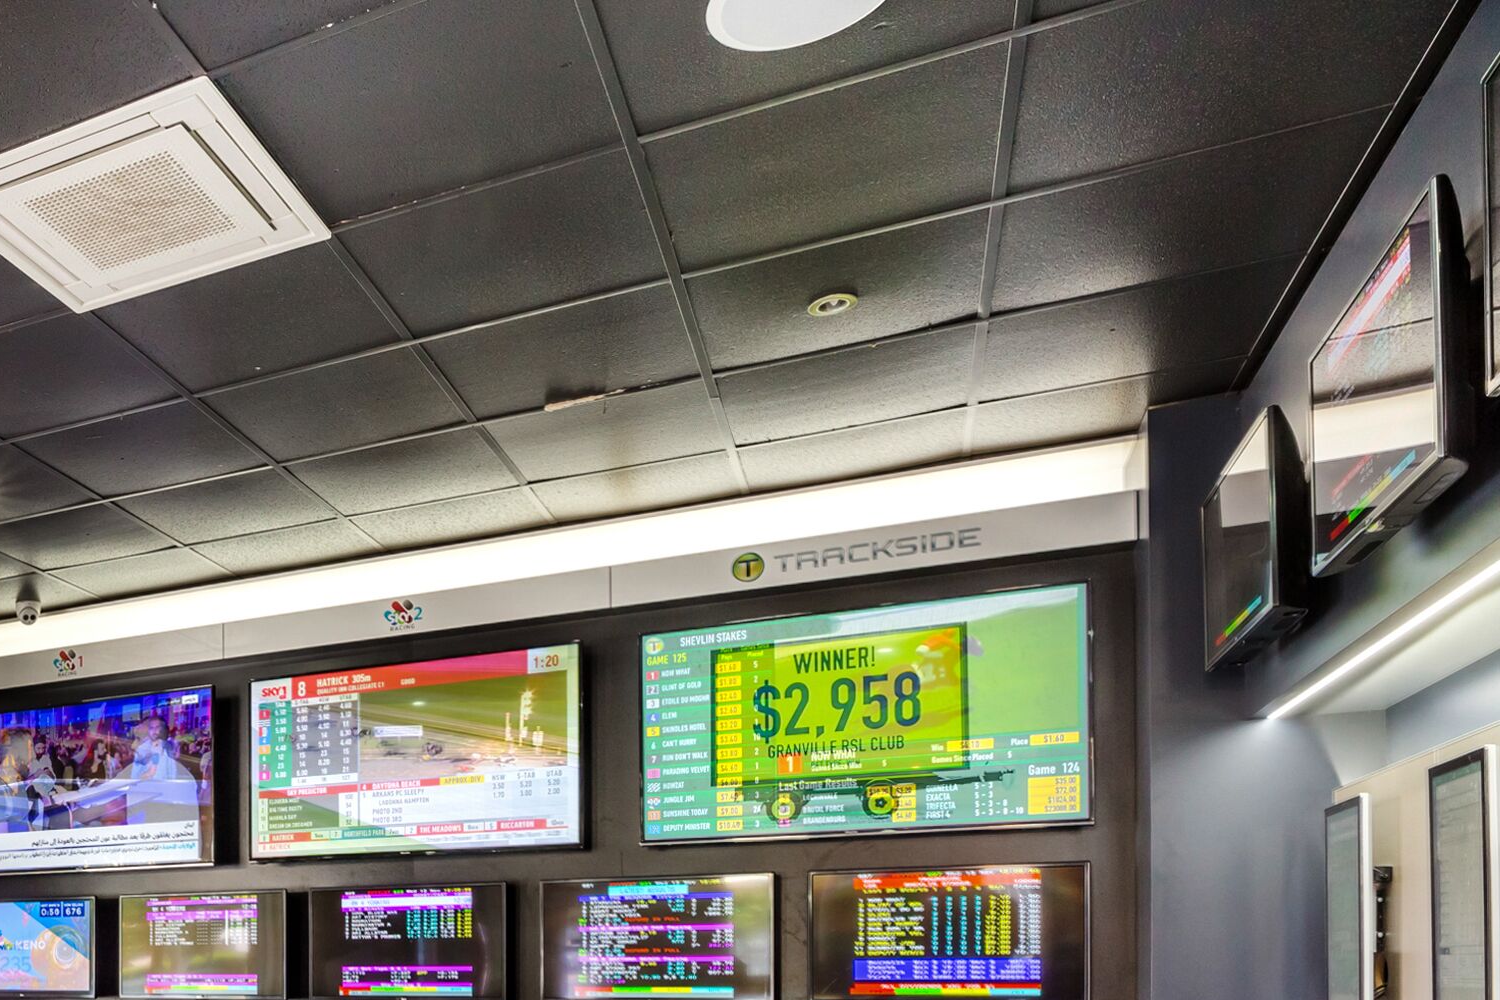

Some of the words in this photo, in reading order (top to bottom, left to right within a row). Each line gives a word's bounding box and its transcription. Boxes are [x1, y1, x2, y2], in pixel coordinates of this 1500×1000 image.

[738, 559, 758, 578] T
[774, 527, 982, 573] TRACKSIDE
[414, 606, 423, 621] 2
[680, 633, 715, 647] SHEVLIN
[716, 630, 747, 643] STAKES
[78, 655, 83, 667] 1
[533, 655, 559, 669] 1:20
[647, 654, 668, 666] GAME
[673, 653, 687, 663] 125
[793, 646, 876, 674] WINNER!
[661, 669, 674, 677] NOW
[675, 668, 690, 676] WHAT
[298, 681, 306, 697] 8
[316, 675, 348, 687] HATRICK
[351, 674, 371, 684] 305m
[753, 671, 921, 743] $2,958
[689, 723, 706, 731] HOTEL
[662, 739, 678, 748] CAN'T
[768, 739, 837, 758] GRANVILLE
[842, 736, 866, 753] RSL
[870, 735, 904, 750] CLUB
[811, 751, 830, 761] NOW
[833, 749, 856, 760] WHAT
[1010, 738, 1028, 746] Place
[1043, 735, 1065, 743] $1.60
[662, 753, 674, 762] RUN
[675, 752, 690, 760] DON'T
[691, 752, 708, 760] WALK
[932, 756, 952, 764] Games
[953, 754, 971, 762] Since
[972, 753, 994, 761] Placed
[691, 765, 710, 774] VELVET
[1028, 764, 1056, 776] Game
[1062, 762, 1080, 773] 124
[372, 781, 399, 790] DAYTONA
[401, 779, 420, 788] BEACH
[779, 781, 797, 791] Last
[799, 780, 823, 790] Game
[825, 777, 857, 788] Results
[926, 793, 951, 801] EXACTA
[926, 802, 956, 810] TRIFECTA
[663, 809, 689, 817] SUNSHINE
[691, 808, 708, 816] TODAY
[926, 811, 946, 819] FIRST
[420, 825, 430, 833] THE
[431, 824, 462, 833] MEADOWS
[500, 820, 534, 829] RICCARTON
[663, 824, 684, 832] DEPUTY
[684, 823, 710, 831] MINISTER
[15, 940, 46, 950] KENO
